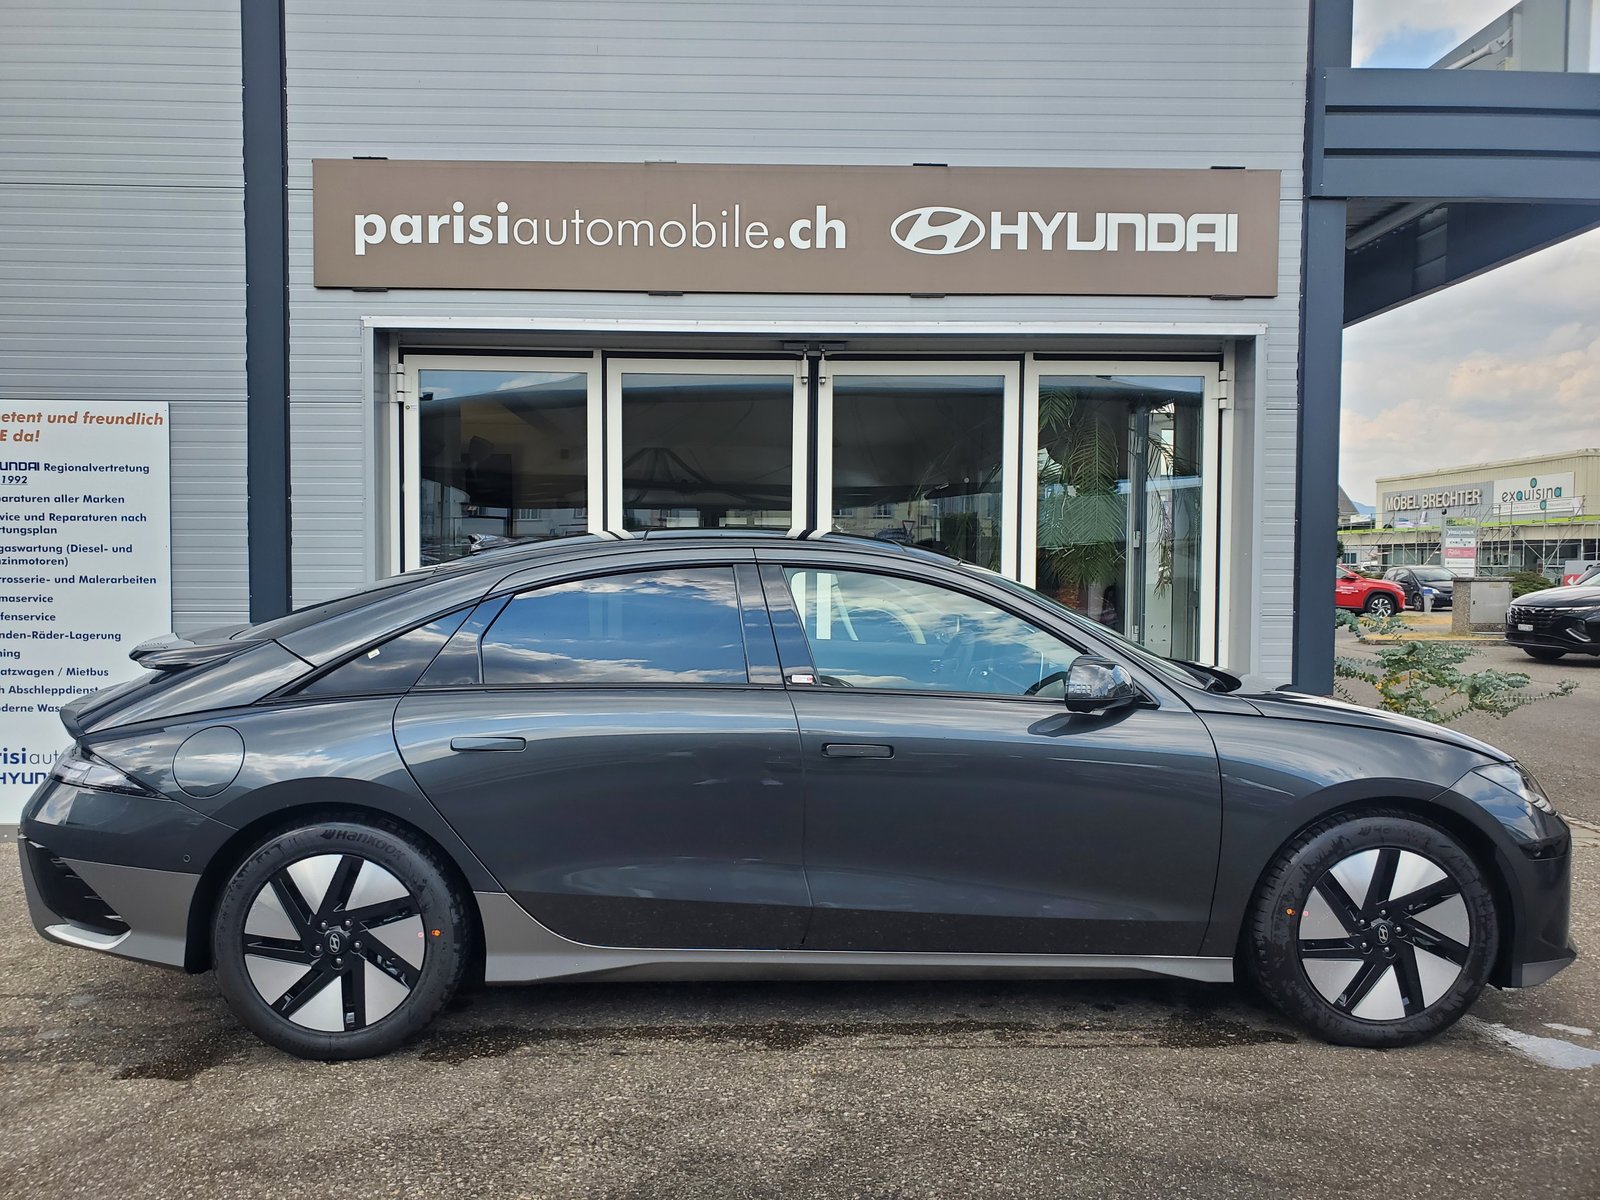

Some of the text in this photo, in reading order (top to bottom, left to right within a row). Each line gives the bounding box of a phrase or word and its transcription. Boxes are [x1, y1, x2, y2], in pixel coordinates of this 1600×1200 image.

[354, 201, 1239, 256] parisiautomobile.ch HYUNDAI
[1, 411, 164, 426] etent und freundlich
[12, 429, 41, 442] da!
[44, 462, 150, 475] Regionalvertretung
[2, 475, 28, 485] 1992
[0, 494, 125, 504] araturen aller Marken
[1422, 488, 1482, 509] BRECHTER
[24, 512, 46, 521] und
[49, 512, 118, 524] Reparaturen
[120, 512, 147, 522] nach
[66, 544, 109, 555] (Diesel-
[111, 544, 133, 554] und
[0, 556, 69, 568] zinmotoren)
[54, 575, 76, 585] und
[78, 574, 157, 585] Malerarbeiten
[0, 611, 57, 622] fenservice
[0, 666, 110, 679] atzwagen / Mietbus
[0, 703, 35, 713] derne
[0, 747, 60, 765] isiaut
